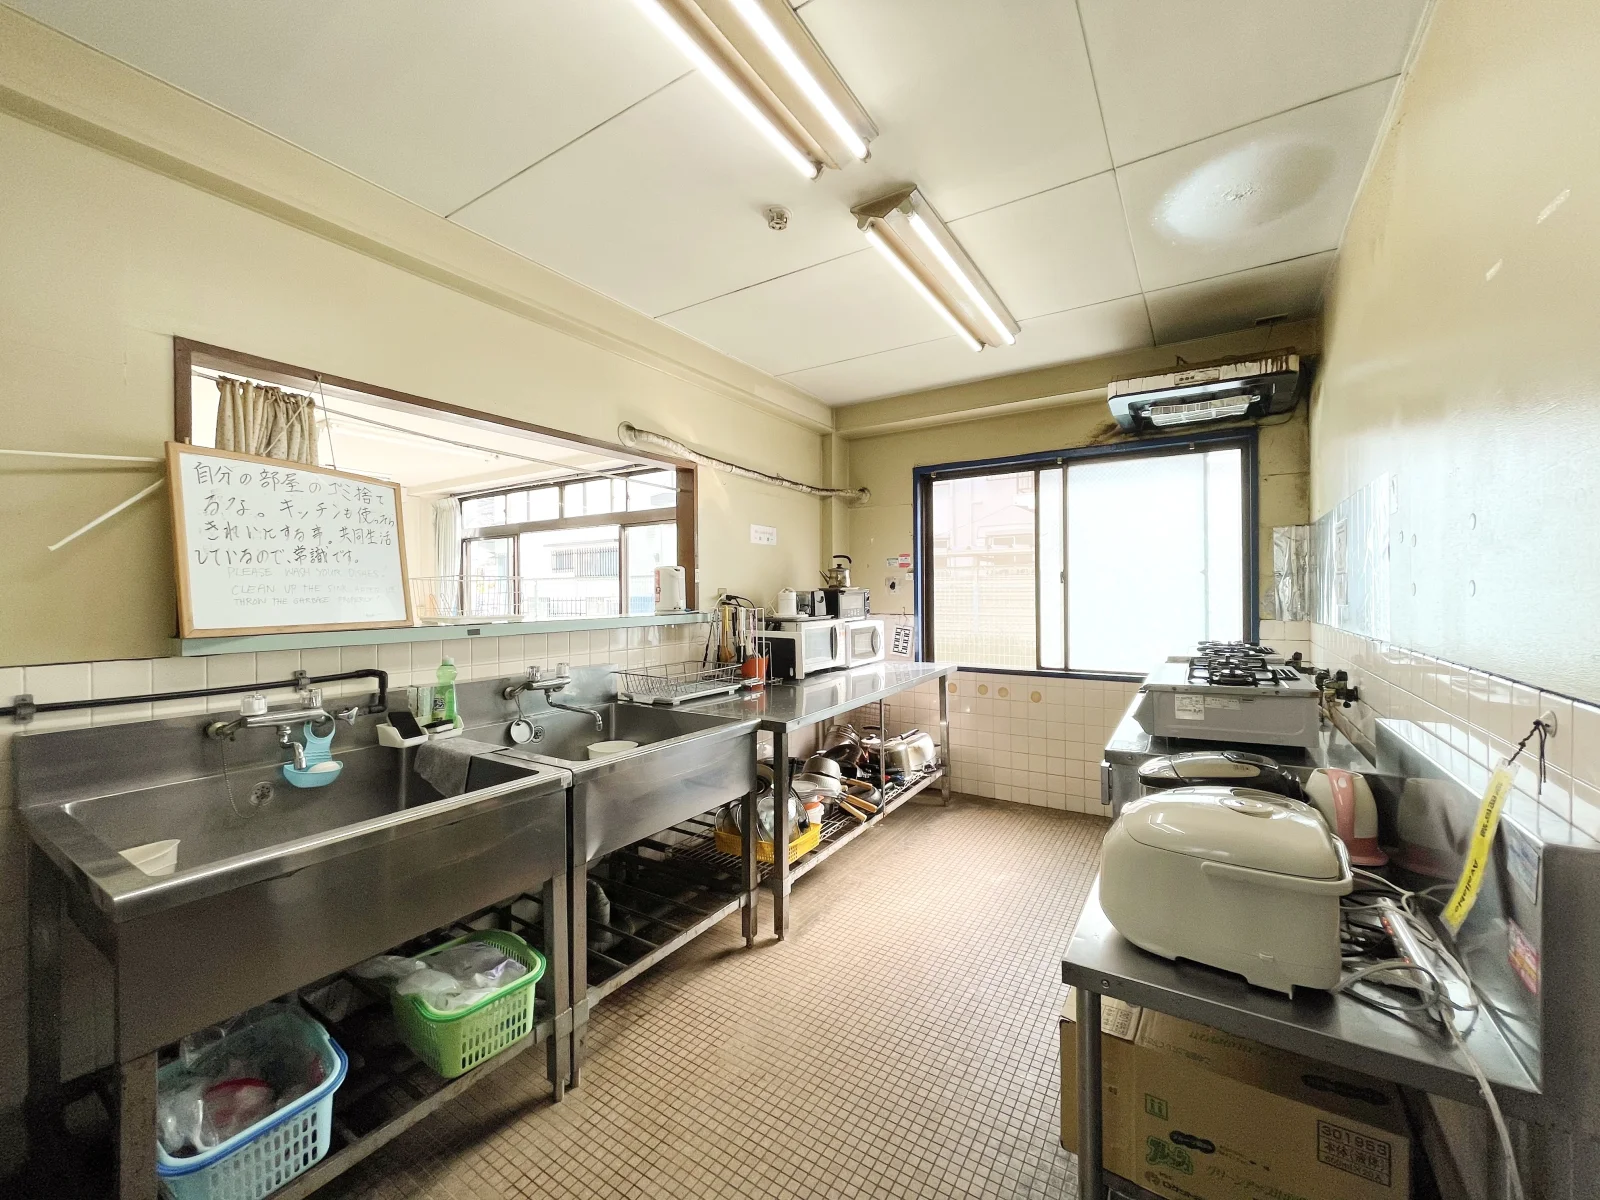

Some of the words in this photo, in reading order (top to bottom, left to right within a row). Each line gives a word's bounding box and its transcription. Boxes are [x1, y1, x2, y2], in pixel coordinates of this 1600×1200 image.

[227, 566, 273, 579] PLEASE
[284, 567, 310, 578] WASH
[315, 567, 342, 578] YOUR
[231, 583, 275, 596] CLEAN
[284, 583, 297, 595] UP
[303, 583, 321, 595] THE
[272, 597, 288, 607] THE
[1321, 1125, 1387, 1156] 301953
